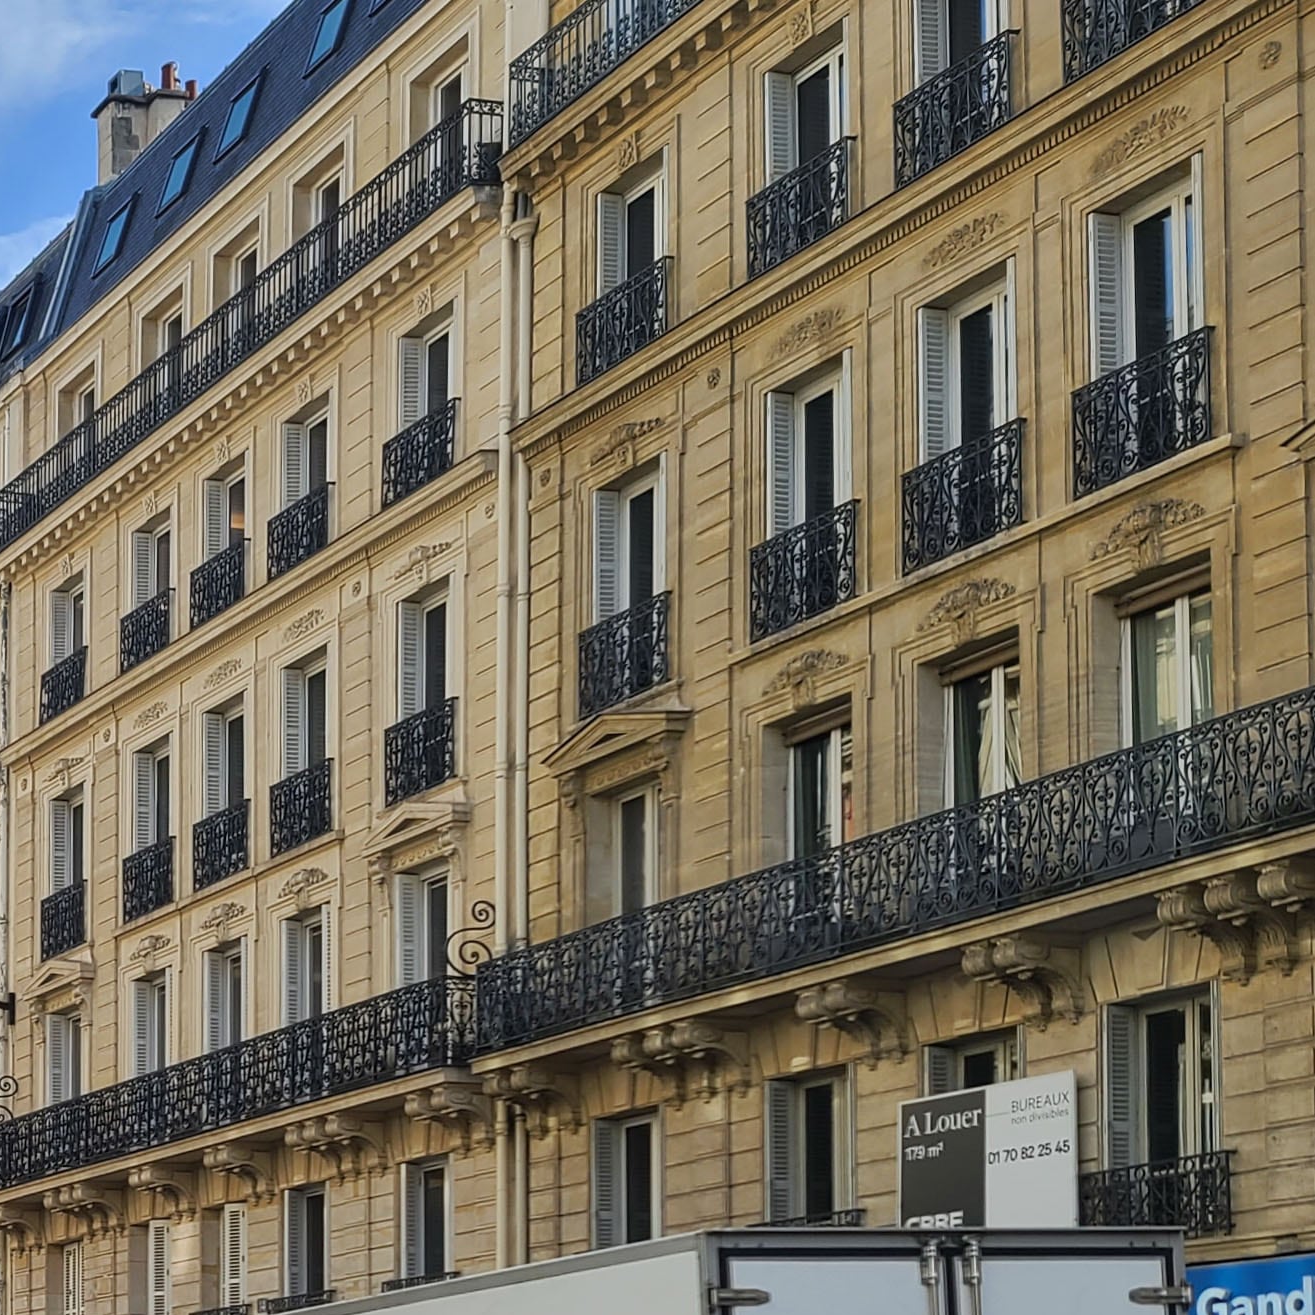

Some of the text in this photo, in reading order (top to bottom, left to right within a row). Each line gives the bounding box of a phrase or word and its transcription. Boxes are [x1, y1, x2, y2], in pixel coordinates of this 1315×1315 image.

[1010, 1091, 1070, 1114] BUREAUX
[924, 1109, 982, 1135] Louer
[1010, 1114, 1027, 1125] non
[988, 1139, 1070, 1165] 01 70 82 25 45
